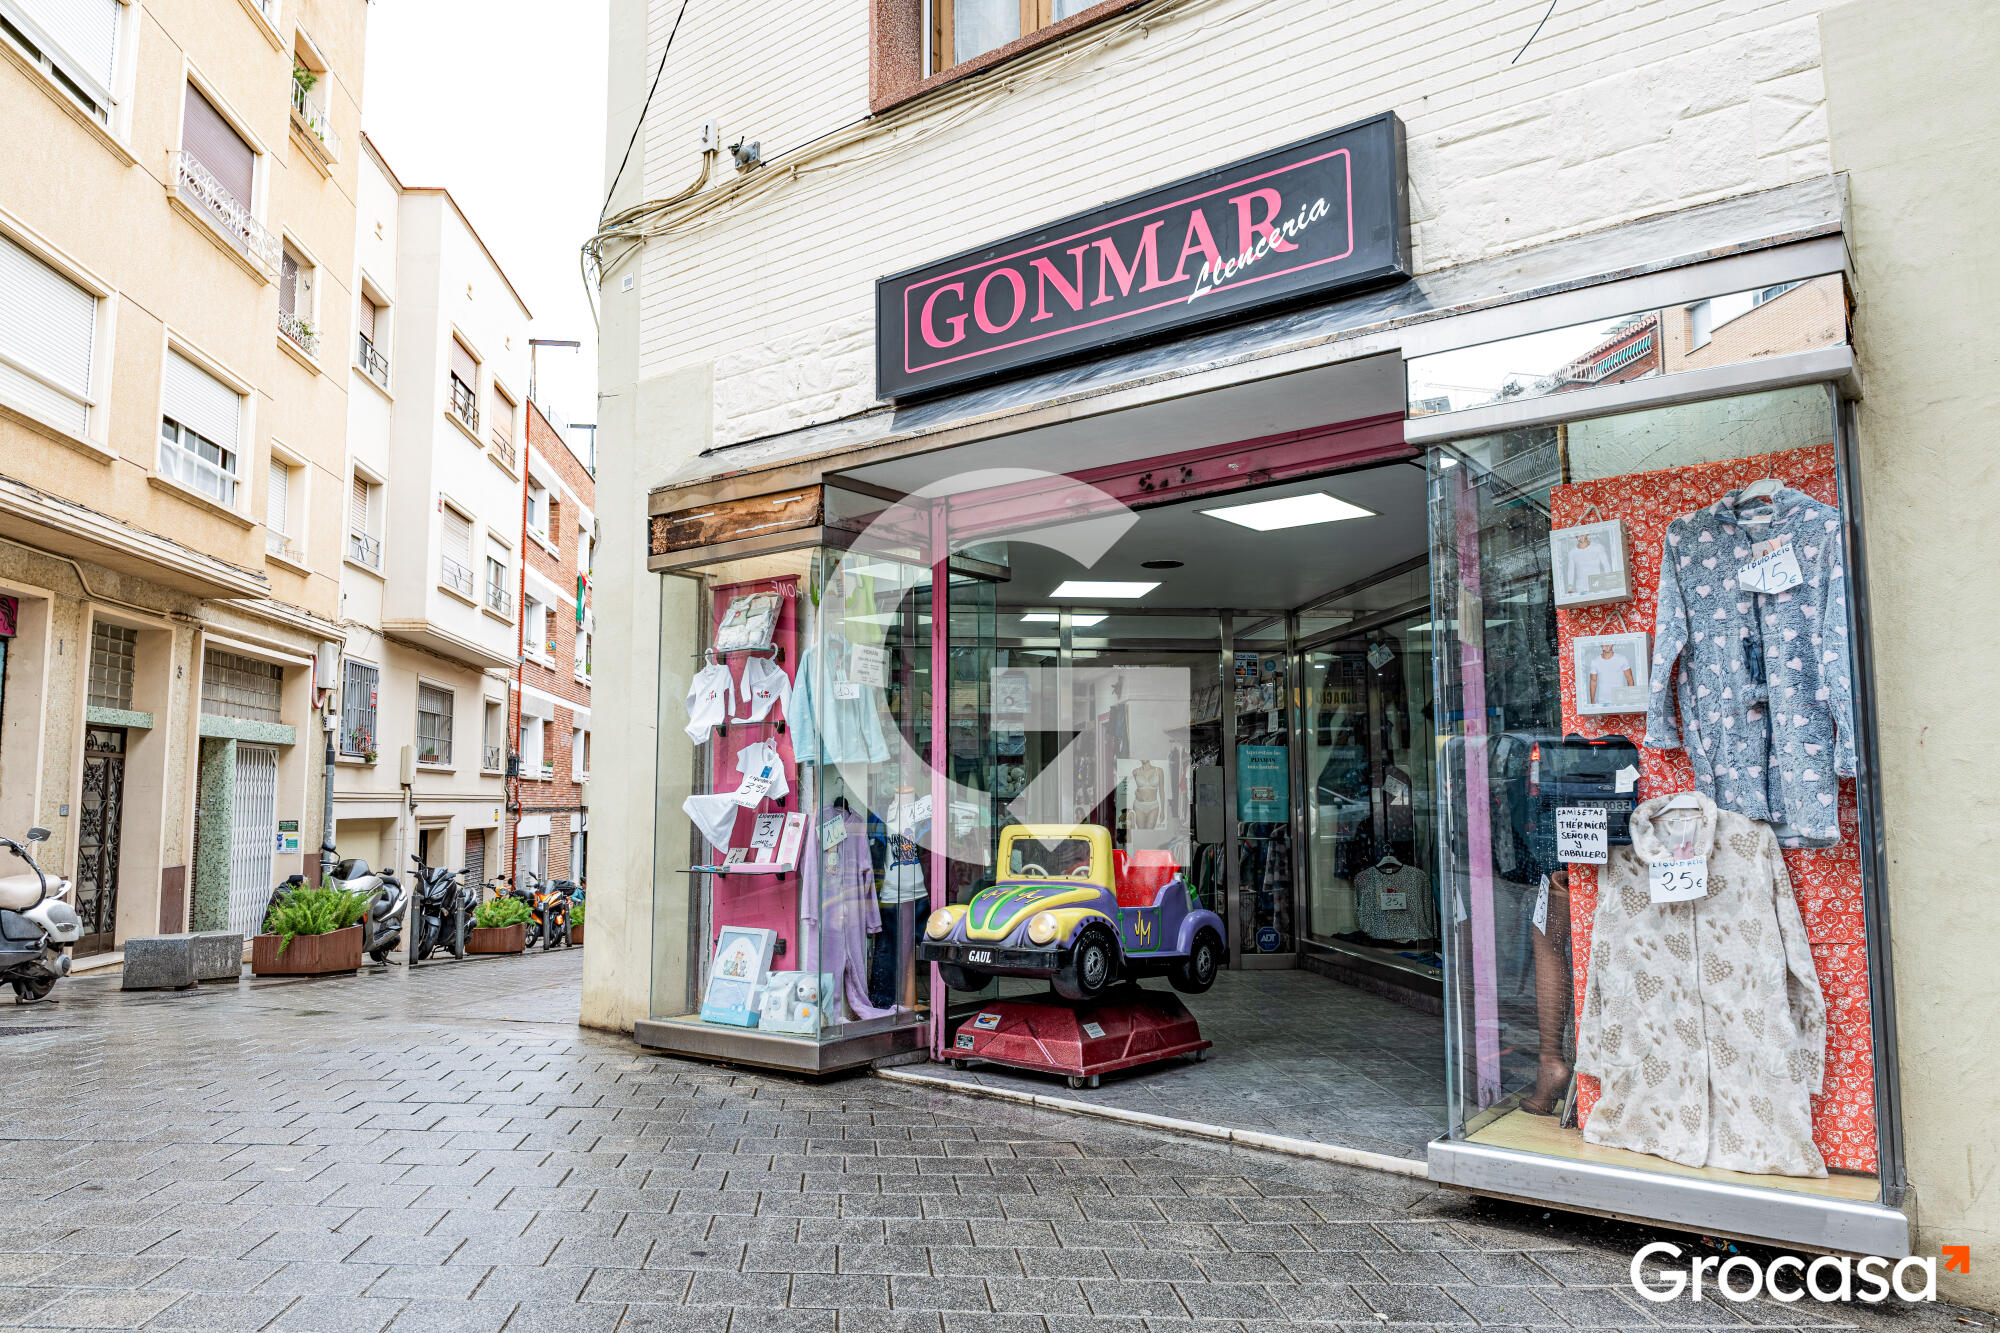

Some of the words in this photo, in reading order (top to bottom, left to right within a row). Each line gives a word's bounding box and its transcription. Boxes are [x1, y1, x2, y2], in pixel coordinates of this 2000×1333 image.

[1187, 196, 1331, 304] Llenceria
[920, 187, 1299, 349] GONMAR
[1755, 562, 1796, 592] 15€
[1557, 809, 1603, 817] CAMISETAS
[1561, 830, 1599, 841] SEÑORA
[1559, 850, 1607, 858] CABALLERO
[1661, 871, 1703, 892] 25€
[1260, 933, 1276, 943] ADT
[968, 950, 992, 963] GAUL
